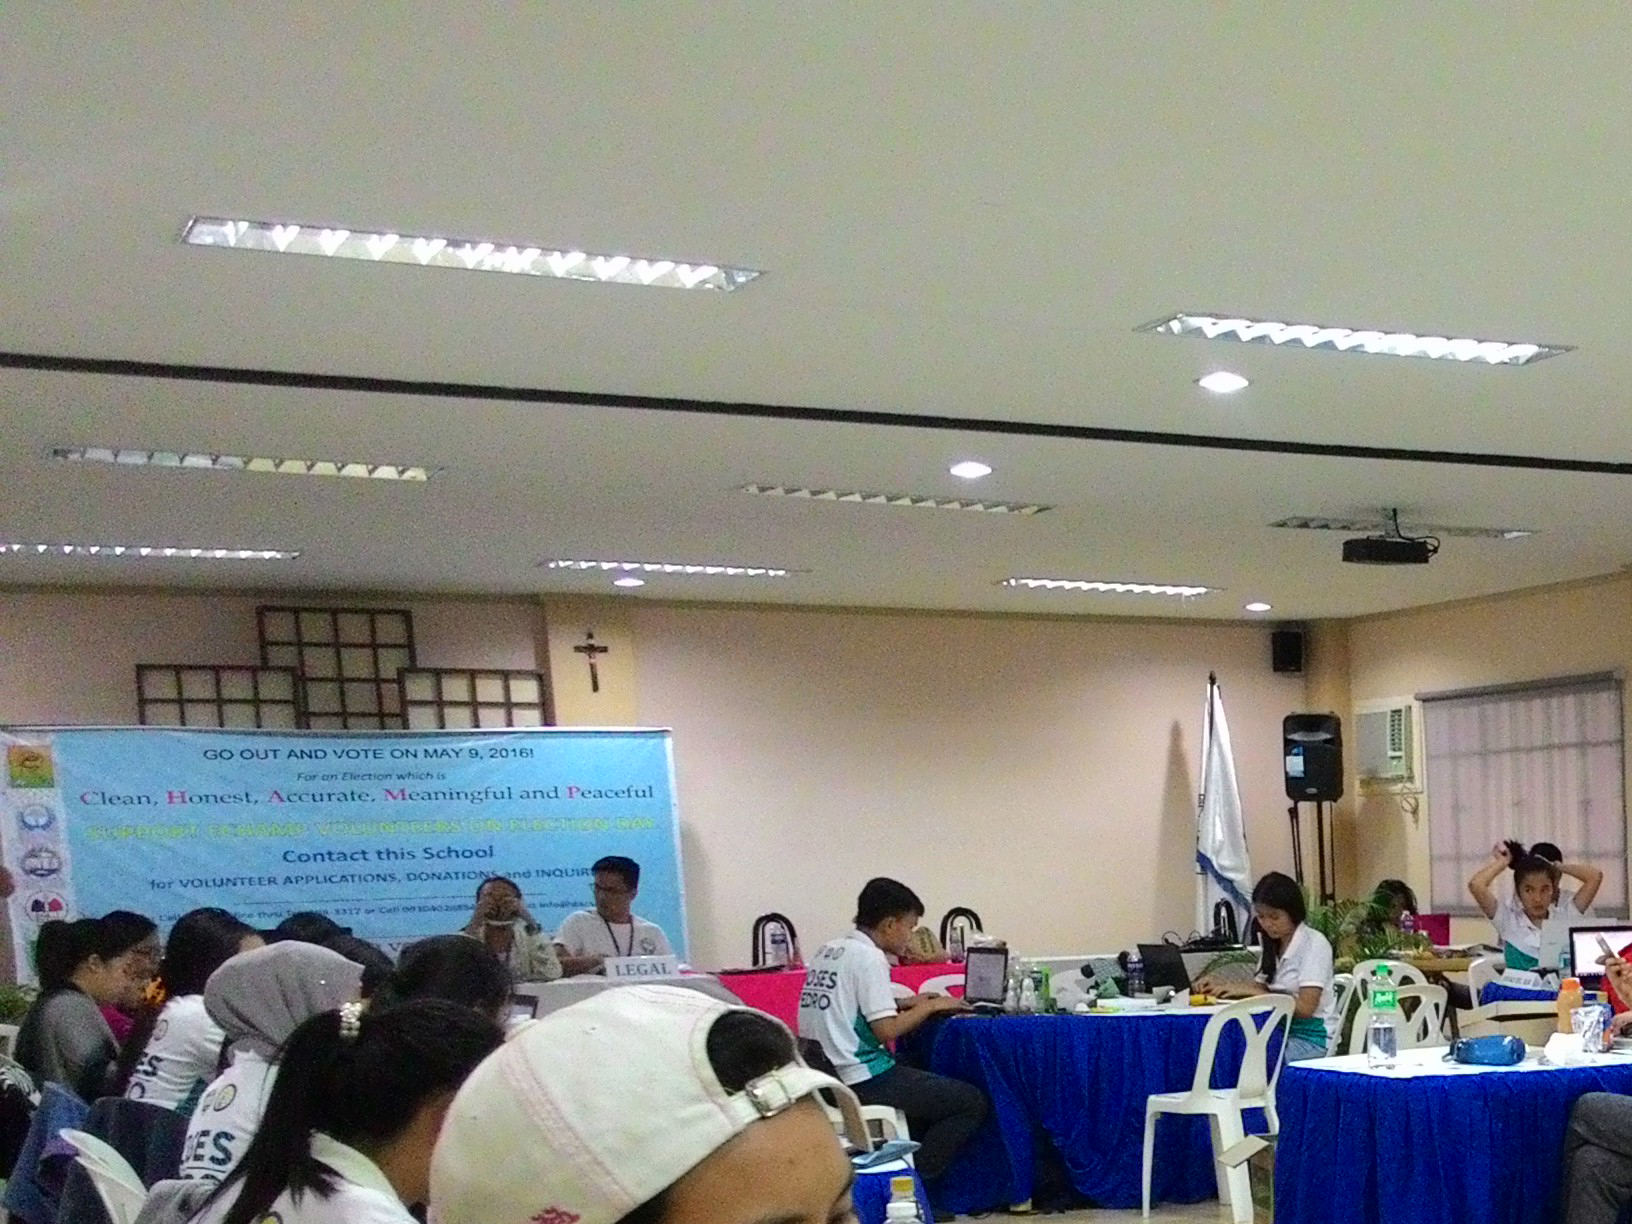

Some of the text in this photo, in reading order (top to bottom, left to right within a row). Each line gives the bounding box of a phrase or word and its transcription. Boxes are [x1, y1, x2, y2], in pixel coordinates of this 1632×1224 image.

[204, 747, 534, 762] GO OUT AND VOTE ON MAY 9, 2016!
[297, 772, 320, 782] For
[341, 771, 394, 782] Election
[396, 771, 434, 782] which
[437, 771, 447, 781] is
[80, 785, 654, 806] Clean, Honest, Accurate, Meaningful and Peaceful
[282, 845, 494, 863] Contact this School
[150, 879, 172, 890] for
[179, 876, 277, 889] VOLUNTEER
[283, 873, 402, 886] APPLICATIONS,
[535, 867, 597, 879] INQUIR
[615, 962, 672, 977] LEGAL
